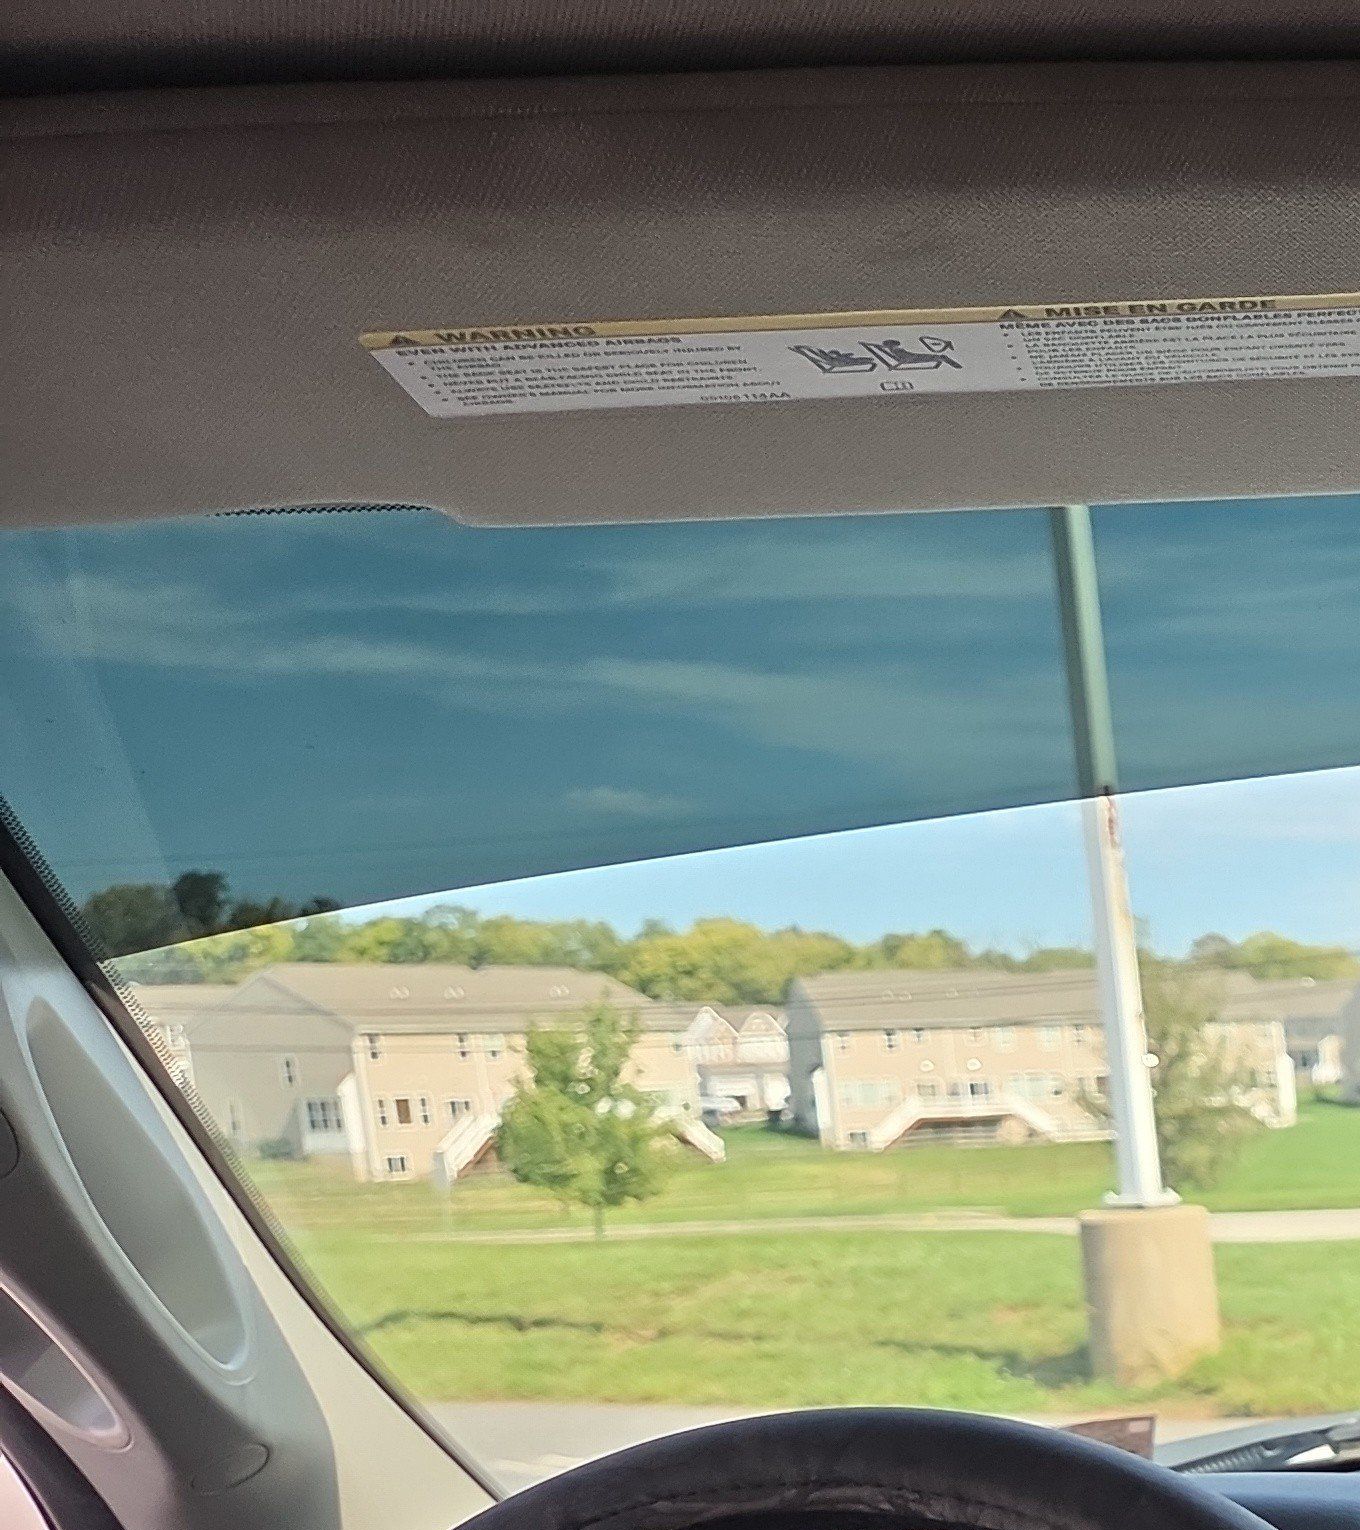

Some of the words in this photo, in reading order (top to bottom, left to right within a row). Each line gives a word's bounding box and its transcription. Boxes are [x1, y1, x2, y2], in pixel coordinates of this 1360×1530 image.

[1045, 306, 1121, 318] MISE
[1128, 303, 1168, 314] EN
[1177, 299, 1276, 313] GARDE
[433, 325, 596, 344] WARNING
